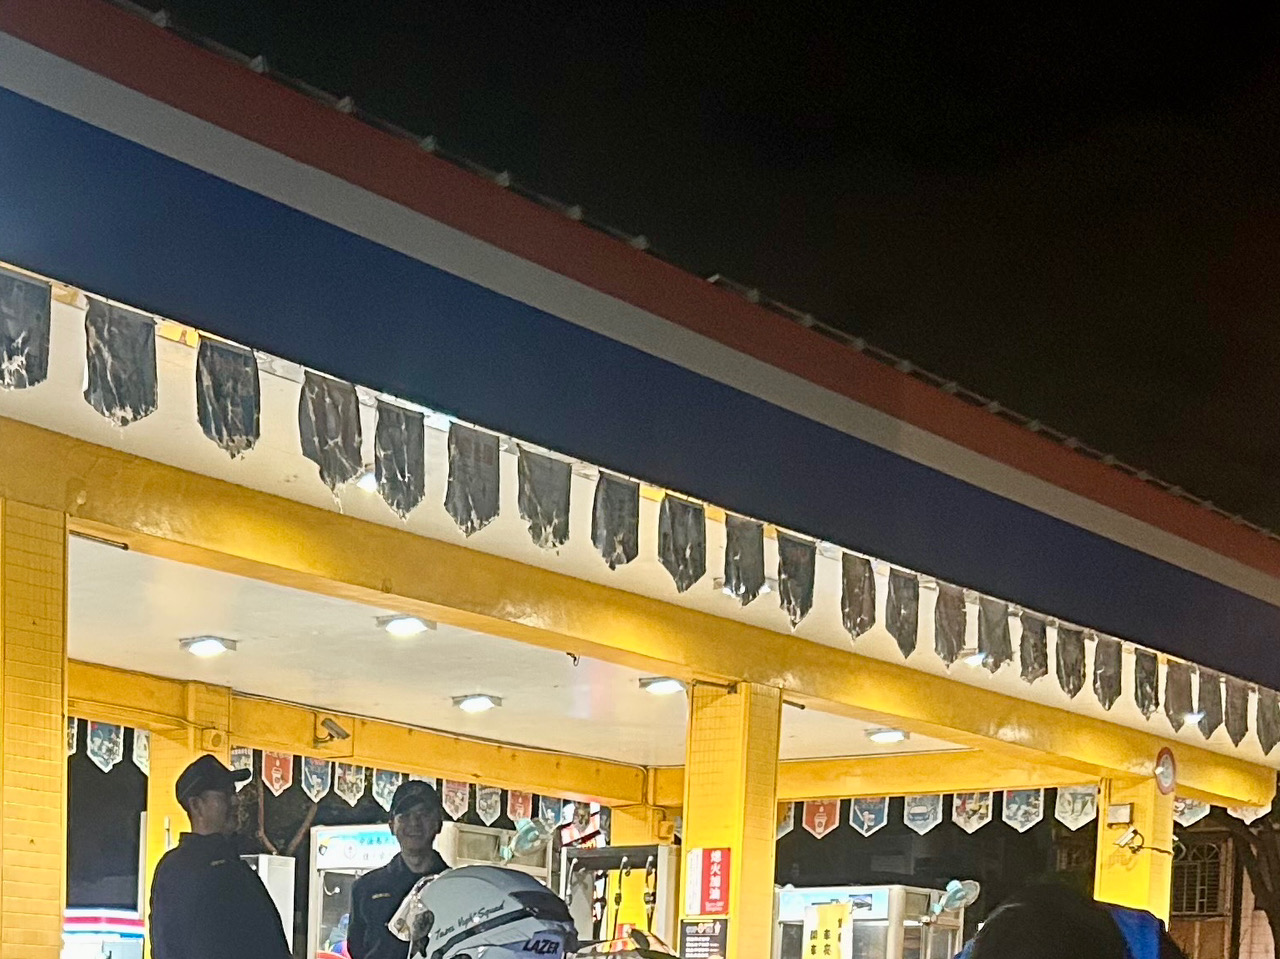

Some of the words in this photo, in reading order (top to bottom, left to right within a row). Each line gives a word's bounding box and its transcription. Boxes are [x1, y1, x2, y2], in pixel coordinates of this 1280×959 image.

[709, 850, 722, 900] 熄火加油
[478, 900, 505, 919] Squad
[522, 939, 560, 955] LAZER
